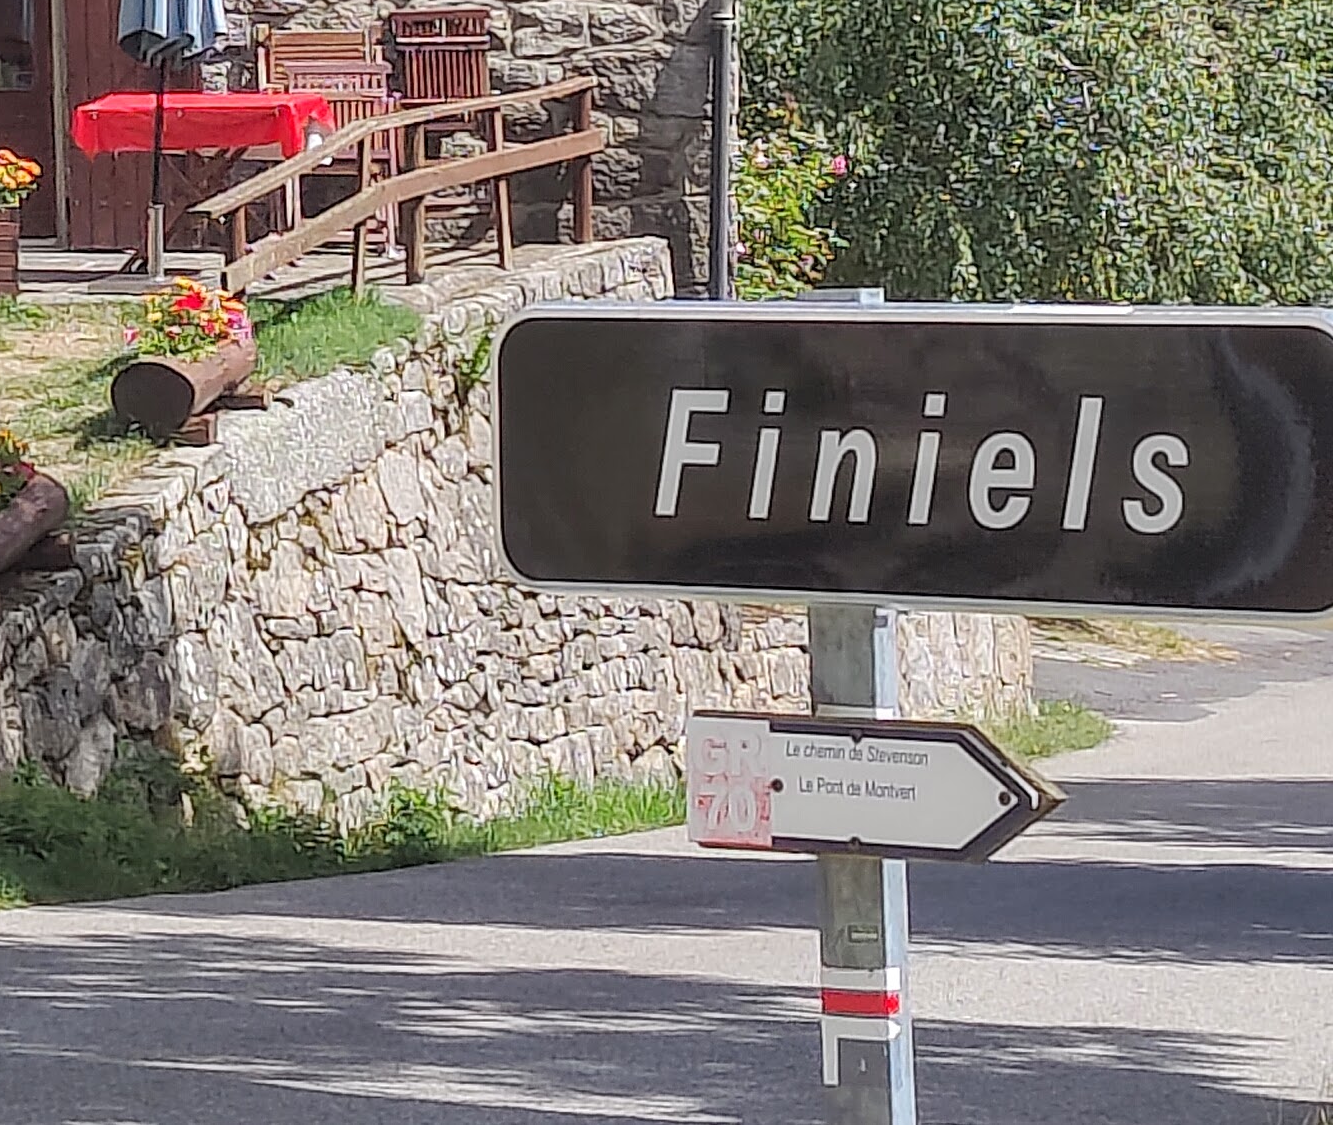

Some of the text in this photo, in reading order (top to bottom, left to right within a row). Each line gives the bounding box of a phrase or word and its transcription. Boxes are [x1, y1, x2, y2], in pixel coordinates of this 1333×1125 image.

[654, 388, 1190, 535] Finiels
[786, 740, 929, 766] Le chemin de Stevenson
[799, 776, 916, 801] Le Pont de Montvert
